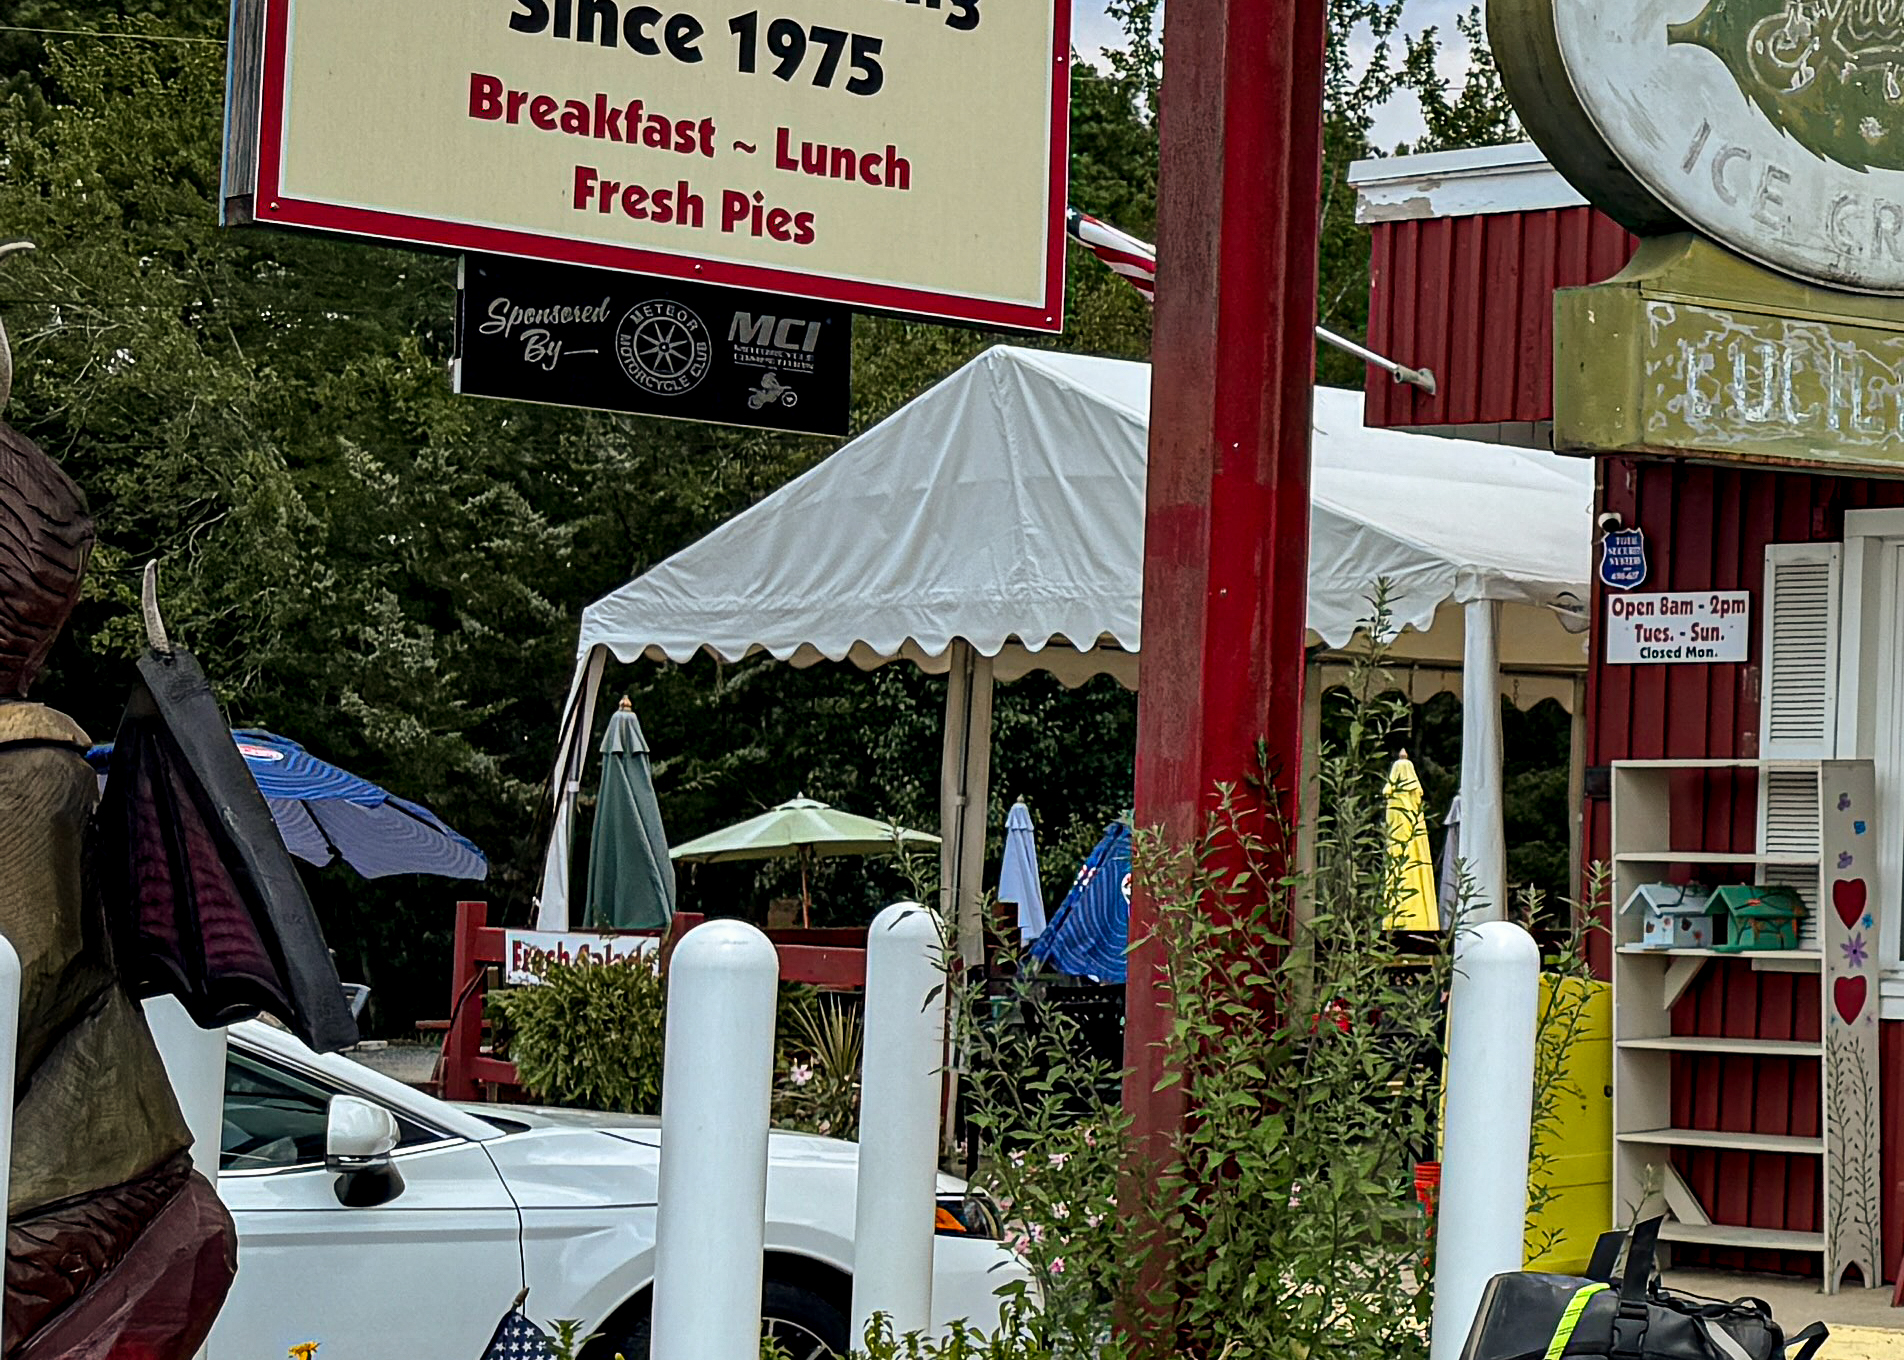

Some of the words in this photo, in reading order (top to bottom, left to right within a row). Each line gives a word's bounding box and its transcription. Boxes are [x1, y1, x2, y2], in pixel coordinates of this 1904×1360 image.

[730, 10, 885, 97] 1975
[468, 72, 717, 160] Breakfast
[774, 125, 914, 193] Lunch
[1680, 120, 1793, 232] ICE
[573, 162, 708, 231] Fresh
[721, 191, 816, 247] Pies
[479, 296, 611, 338] Sponsored
[630, 303, 698, 333] METEOR
[727, 311, 822, 352] MCI
[619, 332, 691, 393] MOTORCYCLE
[690, 340, 709, 378] CLUB
[1611, 597, 1654, 621] Open
[1660, 596, 1693, 616] 8am
[1710, 594, 1746, 619] 2pm
[1634, 623, 1674, 643] Tues.
[1691, 622, 1725, 642] Sun.
[1640, 646, 1682, 659] Closed
[1686, 646, 1718, 658] Mon.
